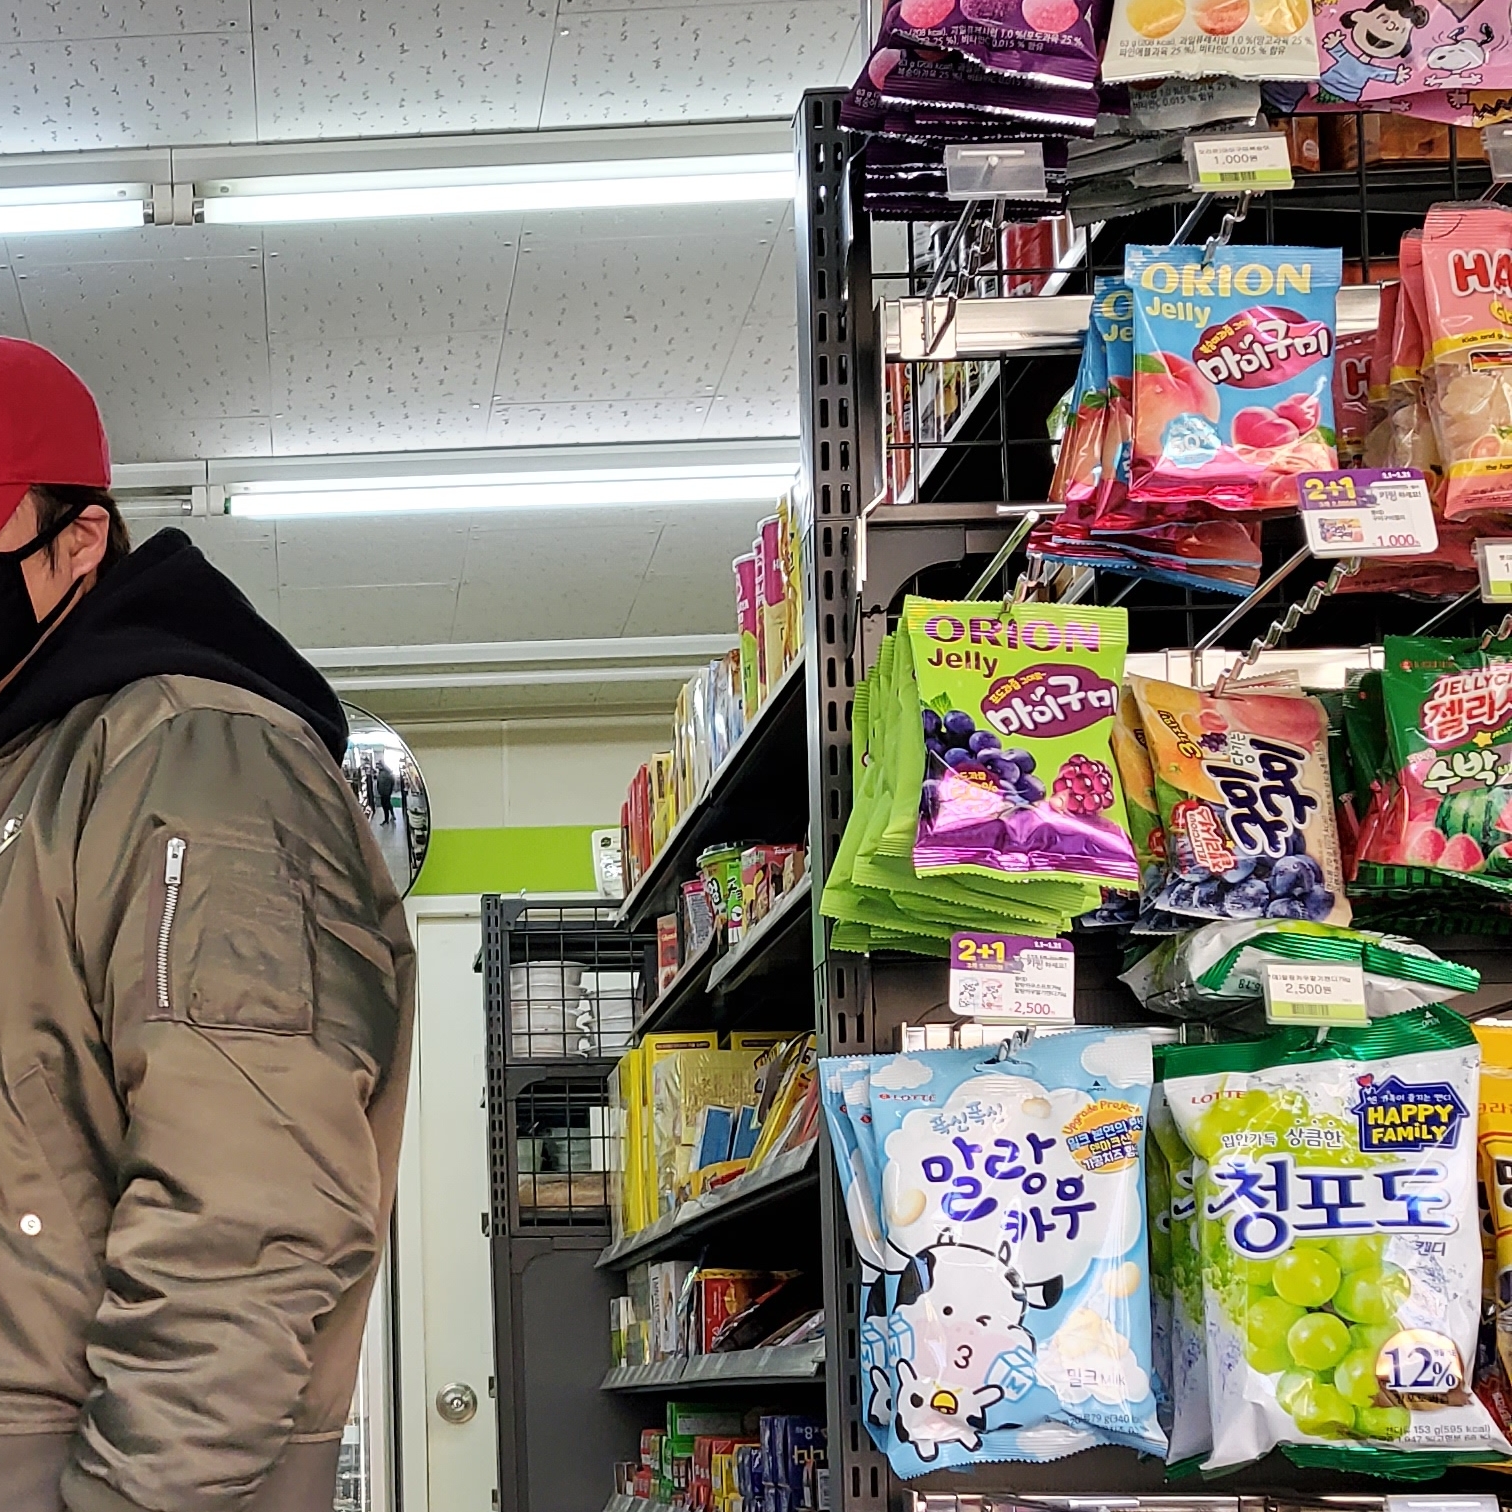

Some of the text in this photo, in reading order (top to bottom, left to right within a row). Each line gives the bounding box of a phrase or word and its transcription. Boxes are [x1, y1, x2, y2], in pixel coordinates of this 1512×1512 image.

[1142, 262, 1312, 298] ORION
[1145, 296, 1211, 328] Jelly
[1197, 320, 1330, 385] 마이구미
[1304, 477, 1356, 501] 2+1
[1376, 534, 1415, 547] 1,000
[925, 615, 1101, 653] ORION
[927, 647, 999, 679] Jelly
[985, 675, 1118, 735] 마이구미
[1423, 749, 1501, 794] 수박
[958, 941, 1006, 962] 2+1
[1285, 983, 1332, 995] 2,500원
[1014, 1001, 1052, 1015] 2,500
[1191, 1089, 1247, 1106] LOTTE
[1367, 1103, 1455, 1127] HAPPY
[1221, 1126, 1343, 1149] 입안가득 상큼한
[921, 1131, 1057, 1222] 말랑
[1206, 1159, 1454, 1254] 청포도
[1066, 1366, 1099, 1389] 밀크
[1387, 1347, 1458, 1389] 12%
